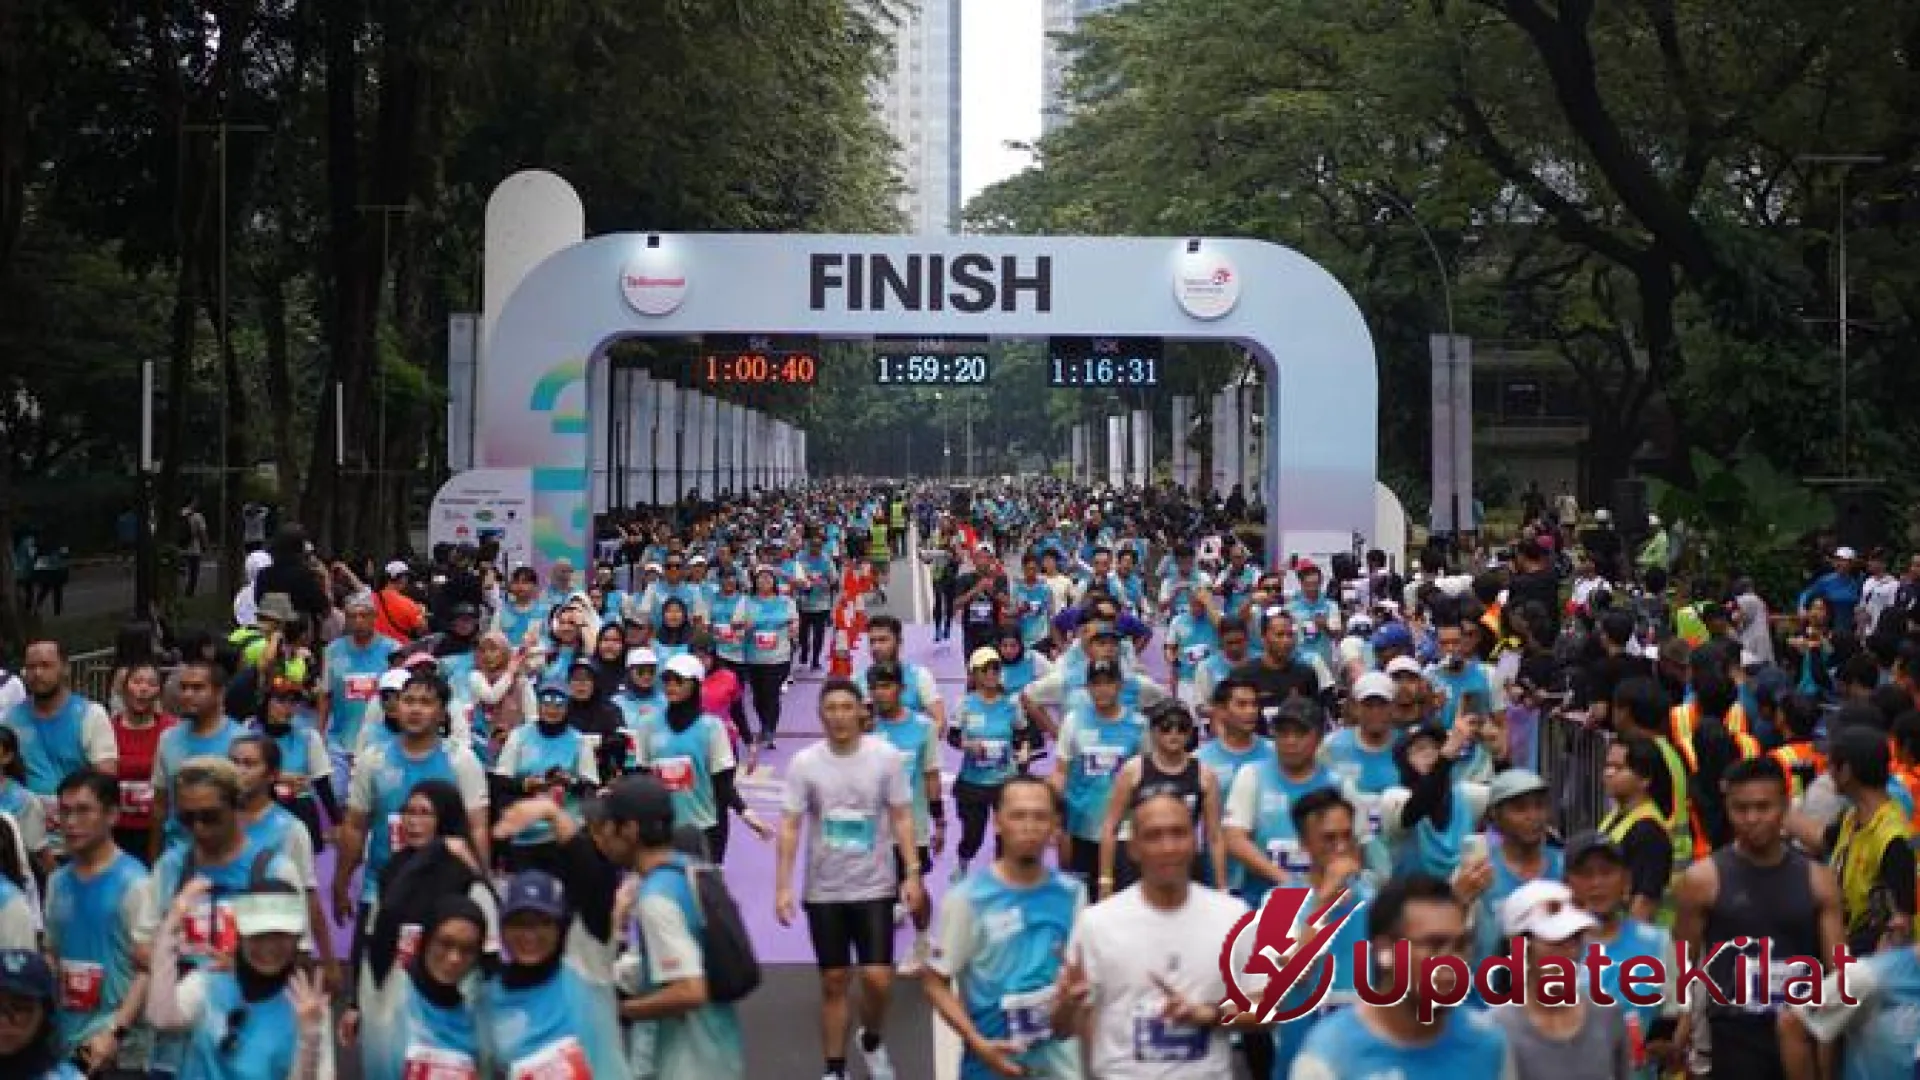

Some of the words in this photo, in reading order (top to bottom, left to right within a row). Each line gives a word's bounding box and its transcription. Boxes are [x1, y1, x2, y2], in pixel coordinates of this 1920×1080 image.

[809, 253, 1052, 313] FINISH
[706, 355, 814, 382] 1:00:40
[878, 355, 985, 382] 1:59:20
[1052, 358, 1157, 383] 1:16:31
